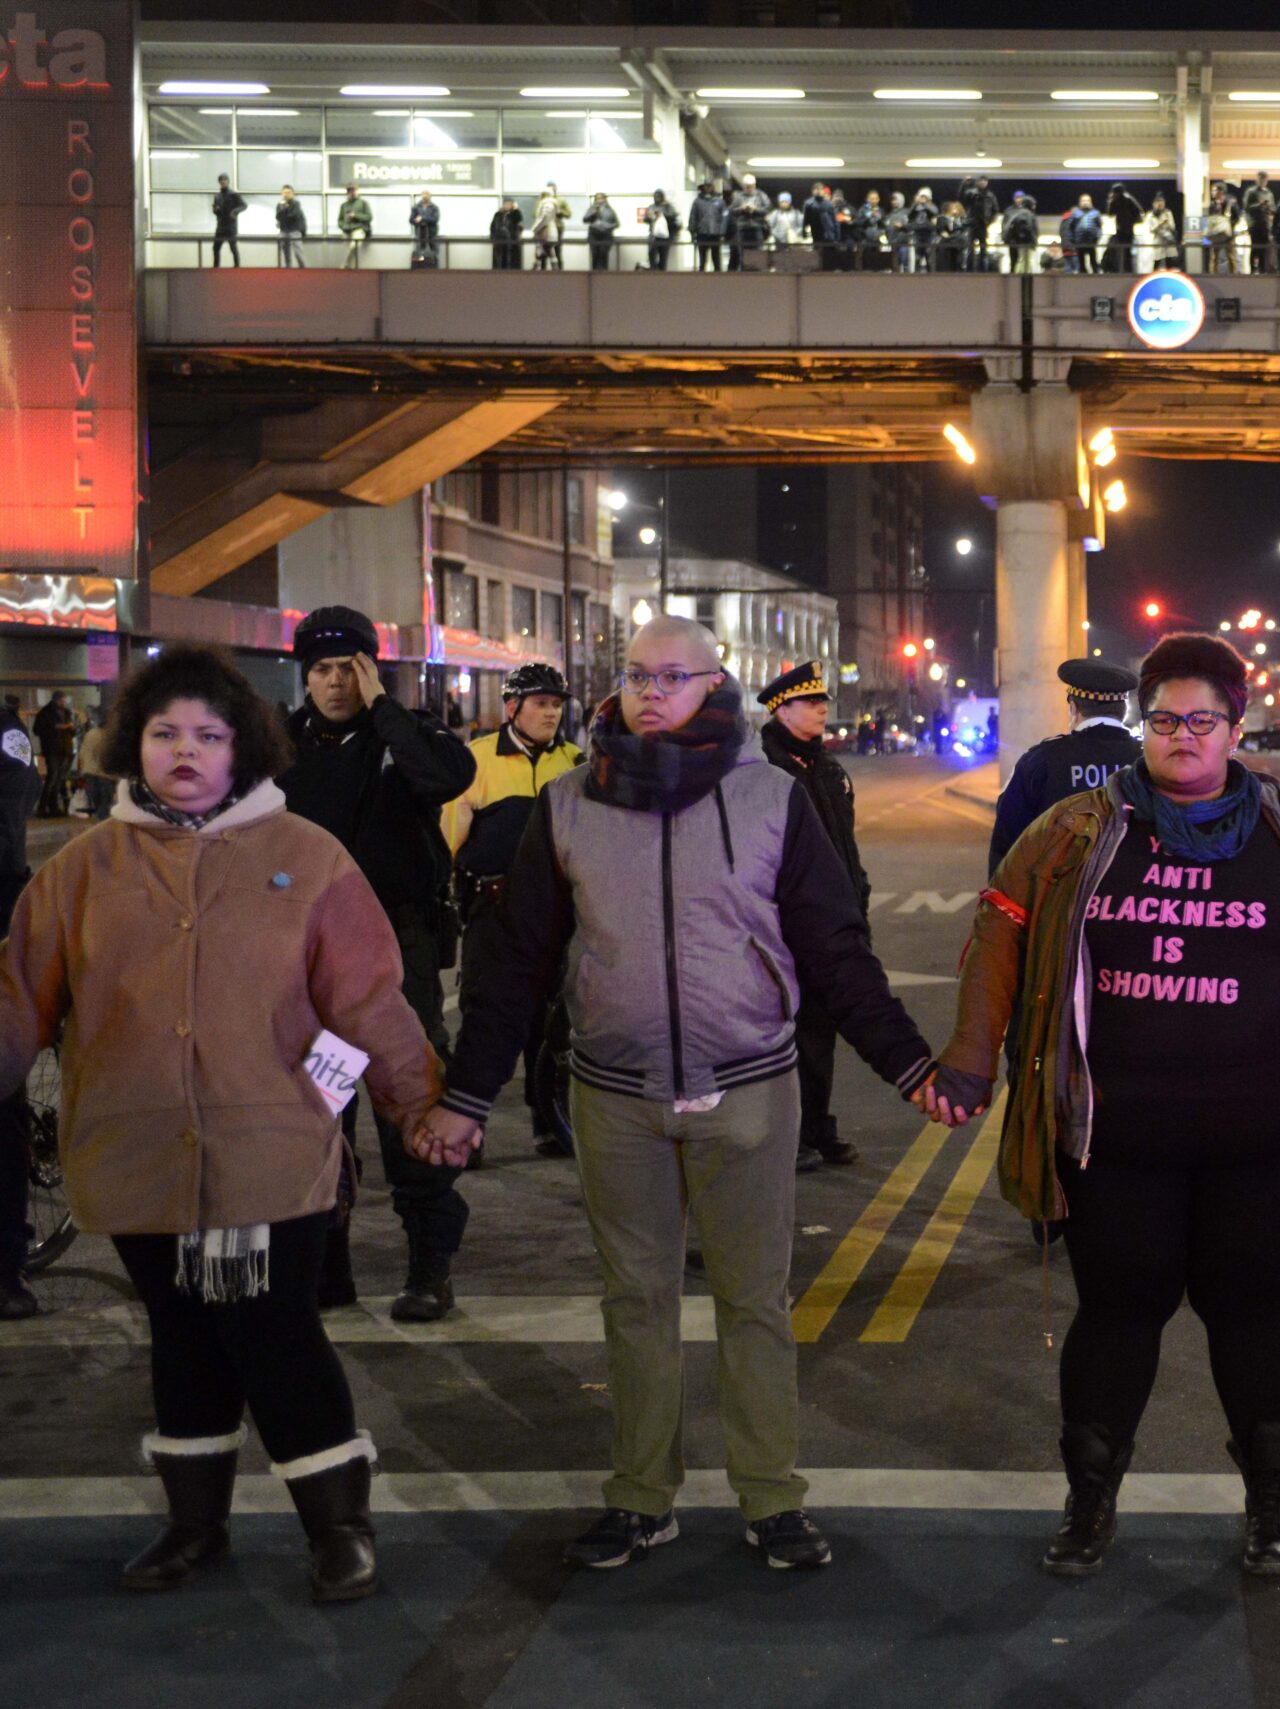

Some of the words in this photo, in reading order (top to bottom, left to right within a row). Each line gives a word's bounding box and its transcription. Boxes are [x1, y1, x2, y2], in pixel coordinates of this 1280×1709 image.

[0, 12, 112, 90] ta
[353, 162, 443, 180] Roosevelt
[1139, 294, 1193, 321] cta
[66, 121, 96, 540] ROOSEVELT
[1142, 863, 1212, 891] ANTI
[1085, 895, 1266, 929] BLACKNESS
[1152, 935, 1185, 964] IS
[1097, 969, 1239, 1005] SHOWING
